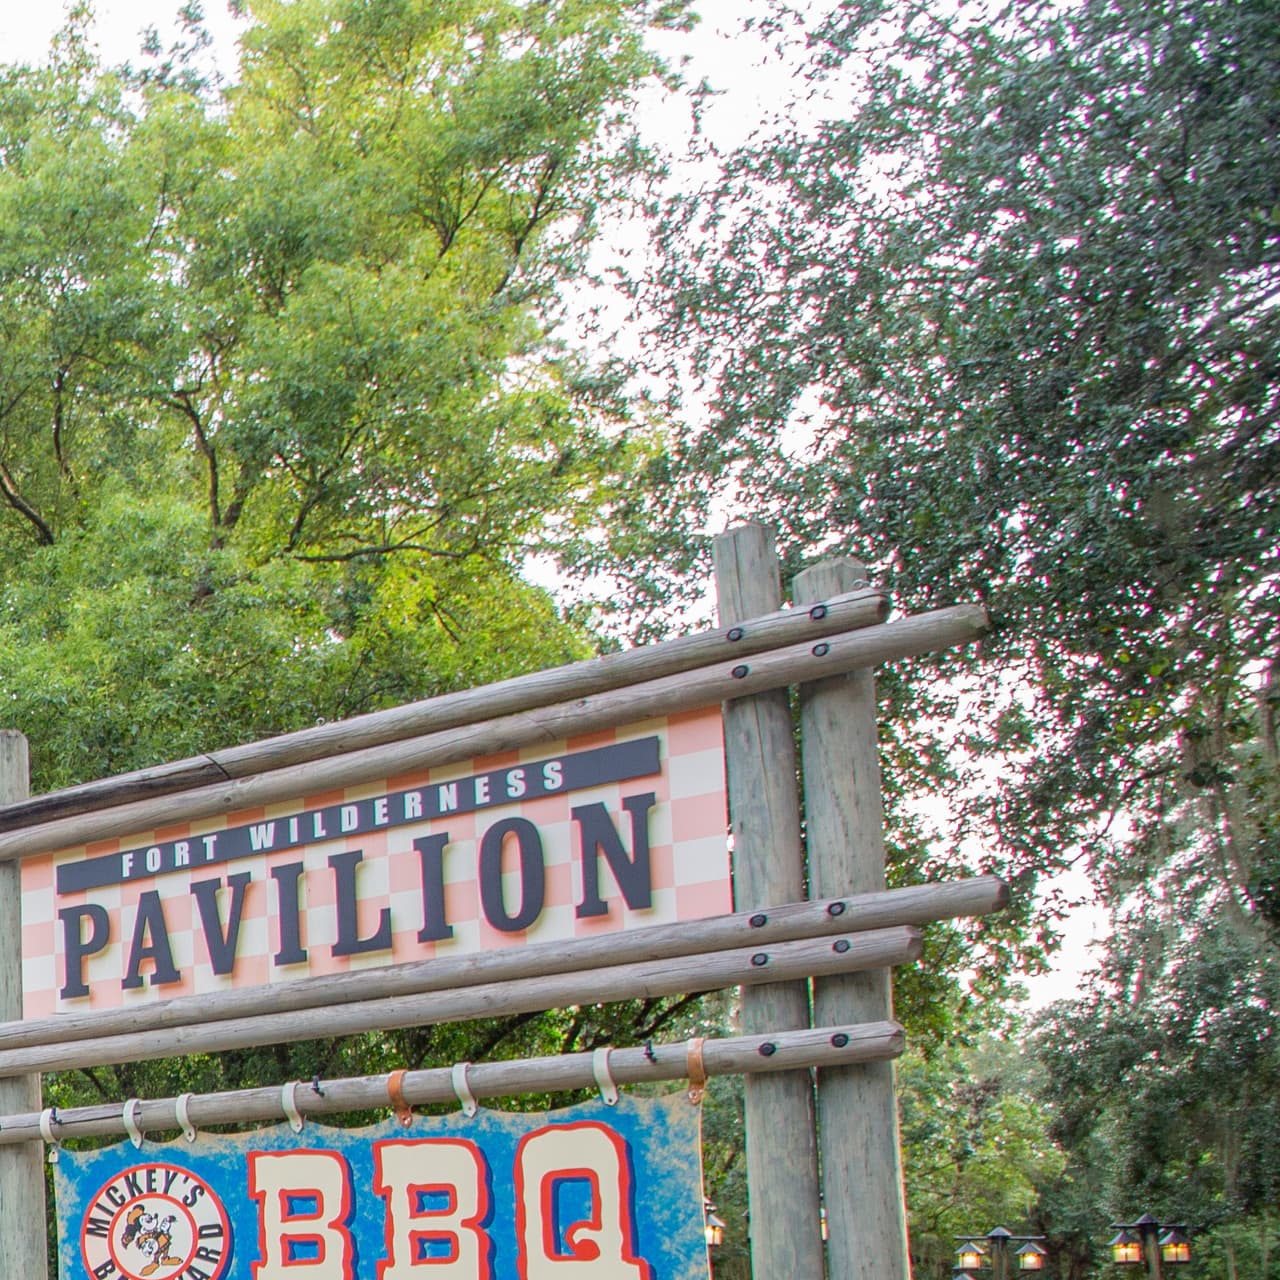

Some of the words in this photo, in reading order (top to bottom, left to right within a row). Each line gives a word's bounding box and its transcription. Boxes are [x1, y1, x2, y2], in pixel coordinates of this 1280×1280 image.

[122, 835, 216, 878] FORT
[248, 760, 565, 851] WILDERNESS
[57, 791, 656, 1000] PAVILION
[86, 1168, 205, 1239] MICKEY'S
